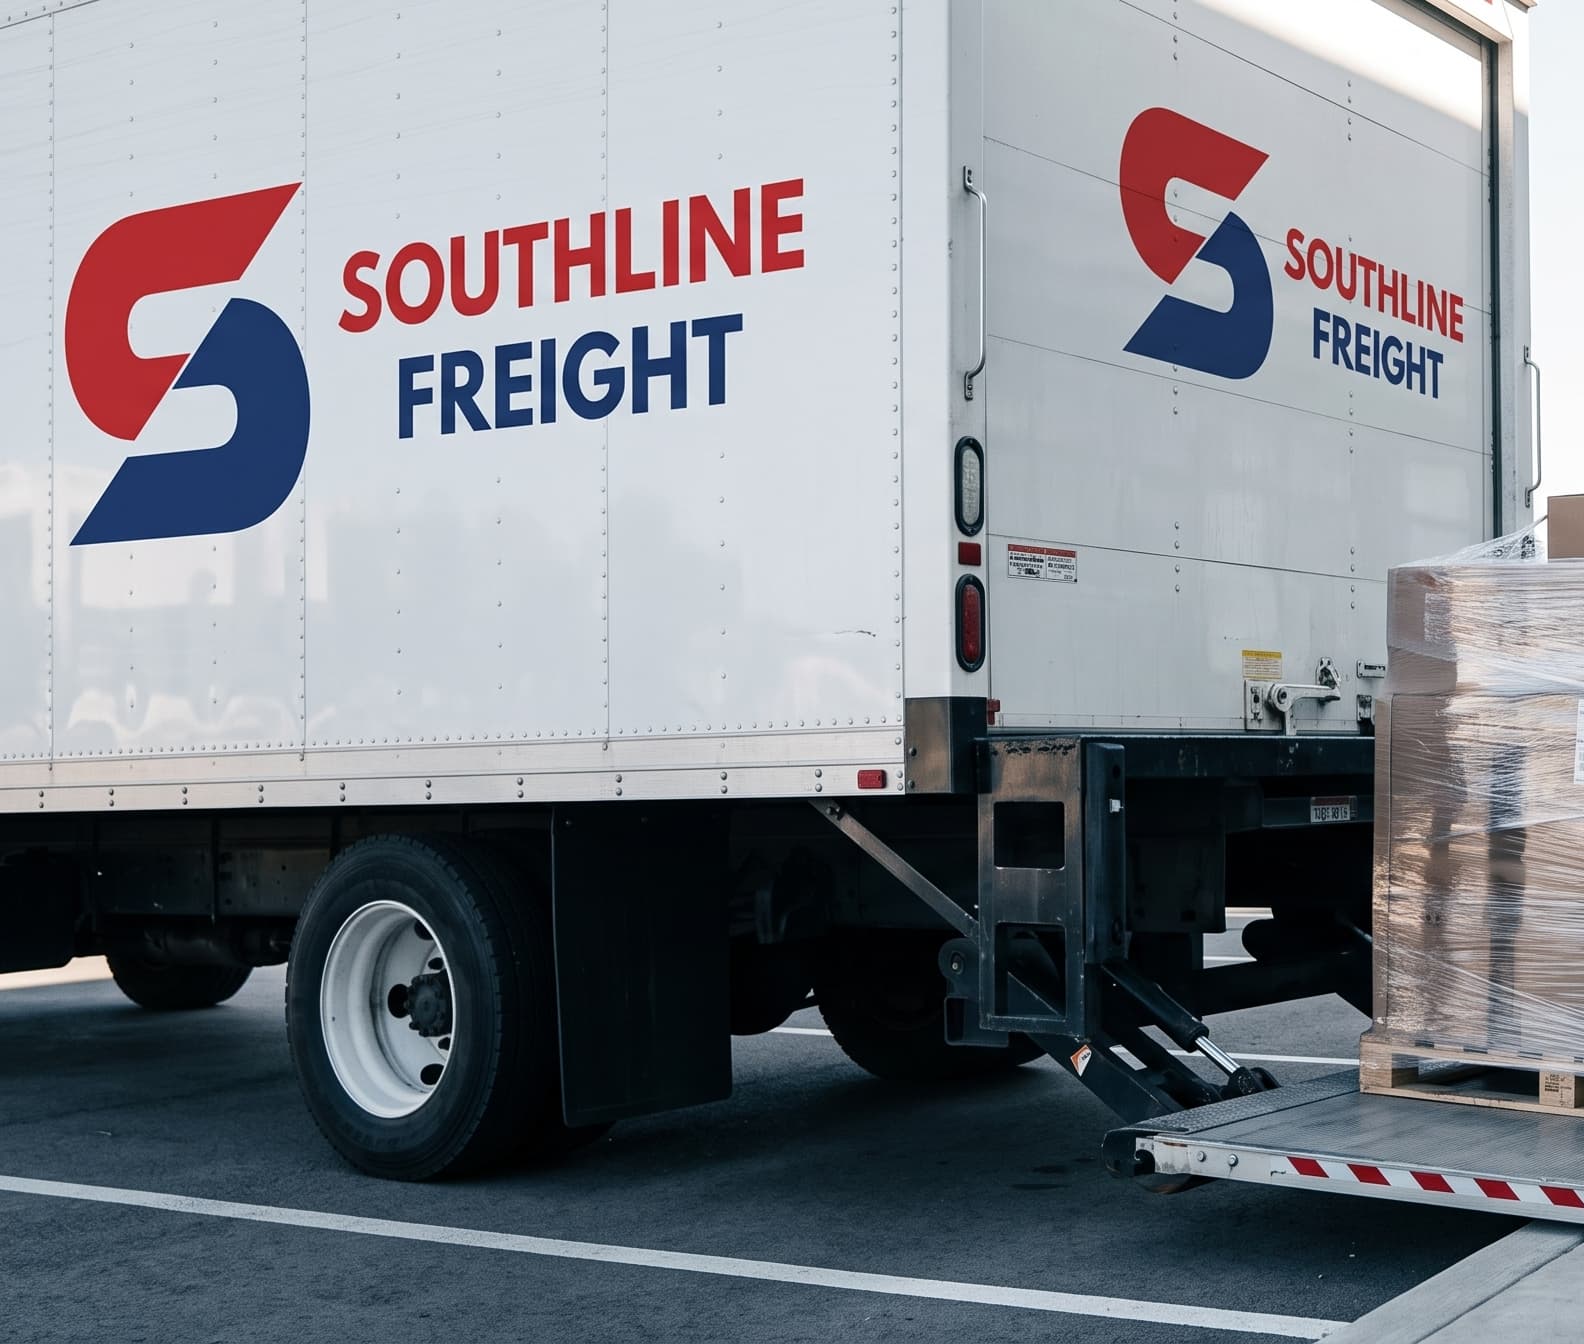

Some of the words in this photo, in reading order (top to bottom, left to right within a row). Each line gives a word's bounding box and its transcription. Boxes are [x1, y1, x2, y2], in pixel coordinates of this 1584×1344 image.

[339, 178, 804, 332] SOUTHLINE
[1284, 228, 1463, 343] SOUTHLINE
[398, 313, 743, 438] FREIGHT
[1313, 307, 1443, 399] FREIGHT
